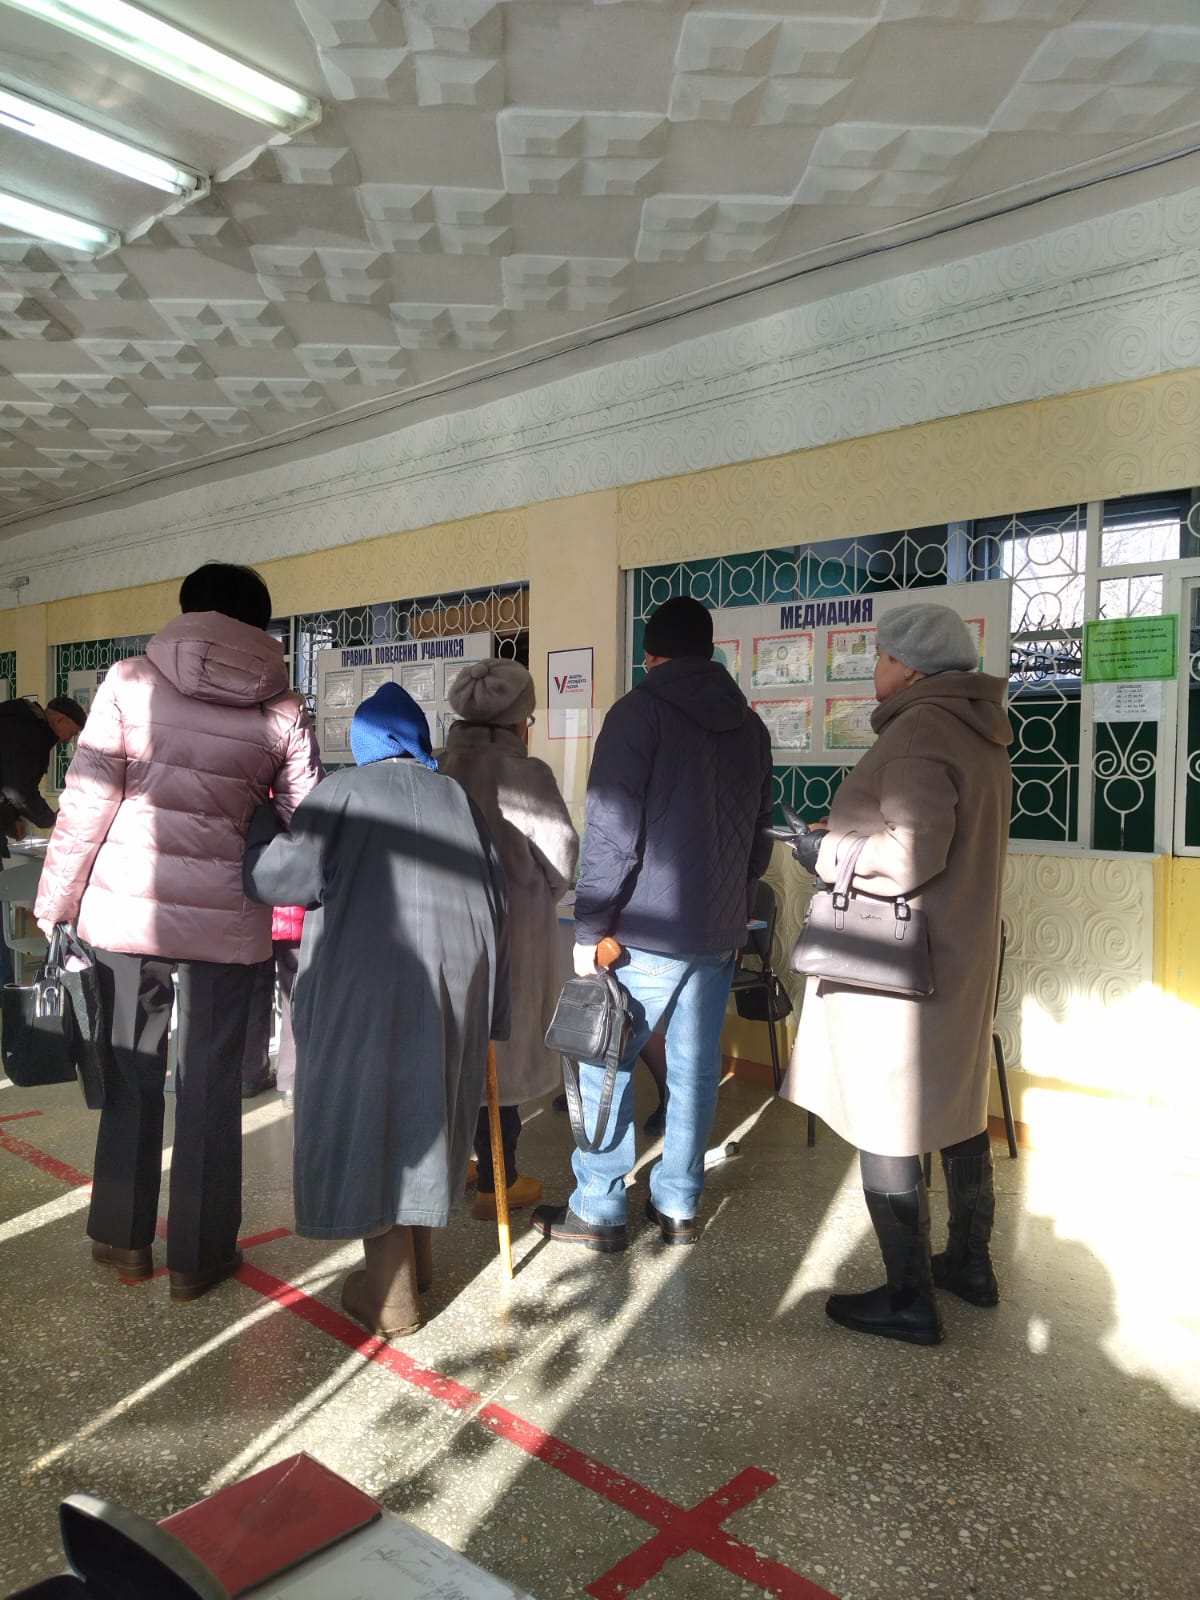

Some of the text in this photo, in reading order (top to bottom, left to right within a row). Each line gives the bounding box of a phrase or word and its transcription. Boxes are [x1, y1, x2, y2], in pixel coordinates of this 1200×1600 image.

[781, 598, 873, 630] МЕДИАЦИЯ
[341, 638, 465, 668] ПРАВИЛА ПОВЕДЕНИЯ УЧАЩИХСЯ
